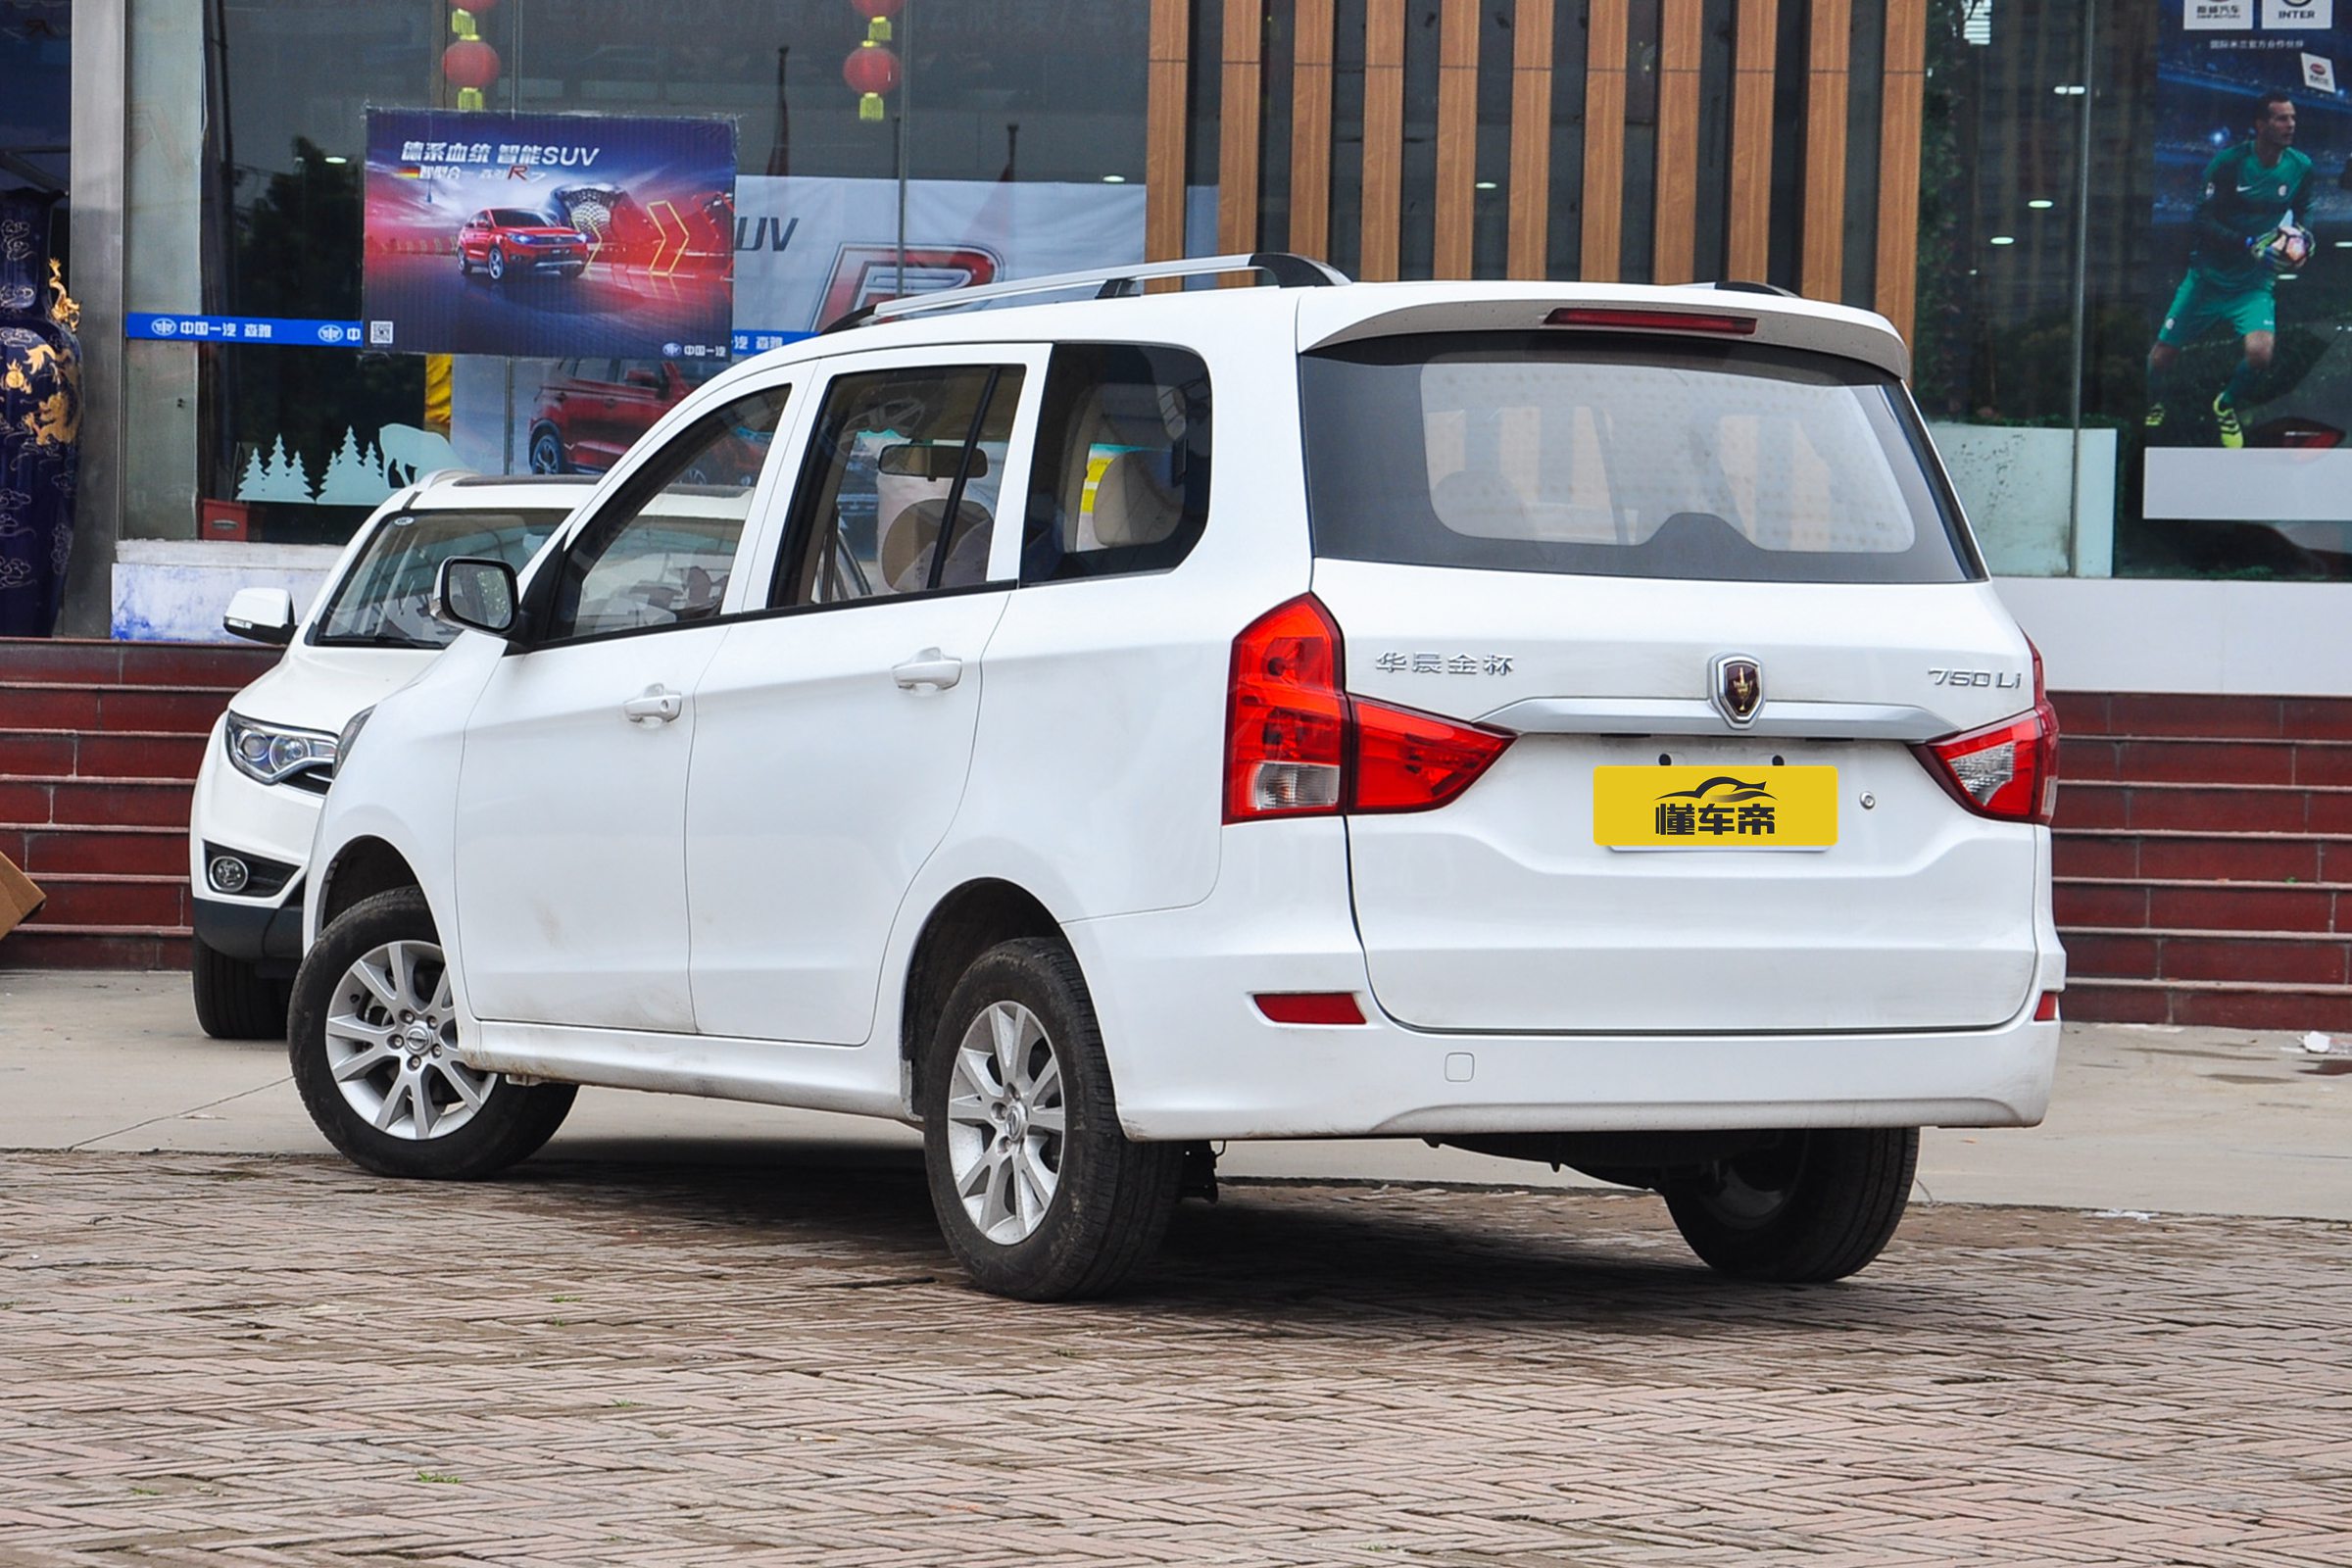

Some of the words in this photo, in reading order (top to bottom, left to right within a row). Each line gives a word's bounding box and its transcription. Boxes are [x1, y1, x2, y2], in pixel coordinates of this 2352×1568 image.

[2278, 10, 2315, 19] INTER
[401, 140, 492, 163] 德系血统
[497, 143, 600, 166] 智能SUV
[179, 320, 236, 337] 中国一汽
[684, 345, 726, 358] 中国一汽
[1376, 651, 1514, 675] 华晨金杯
